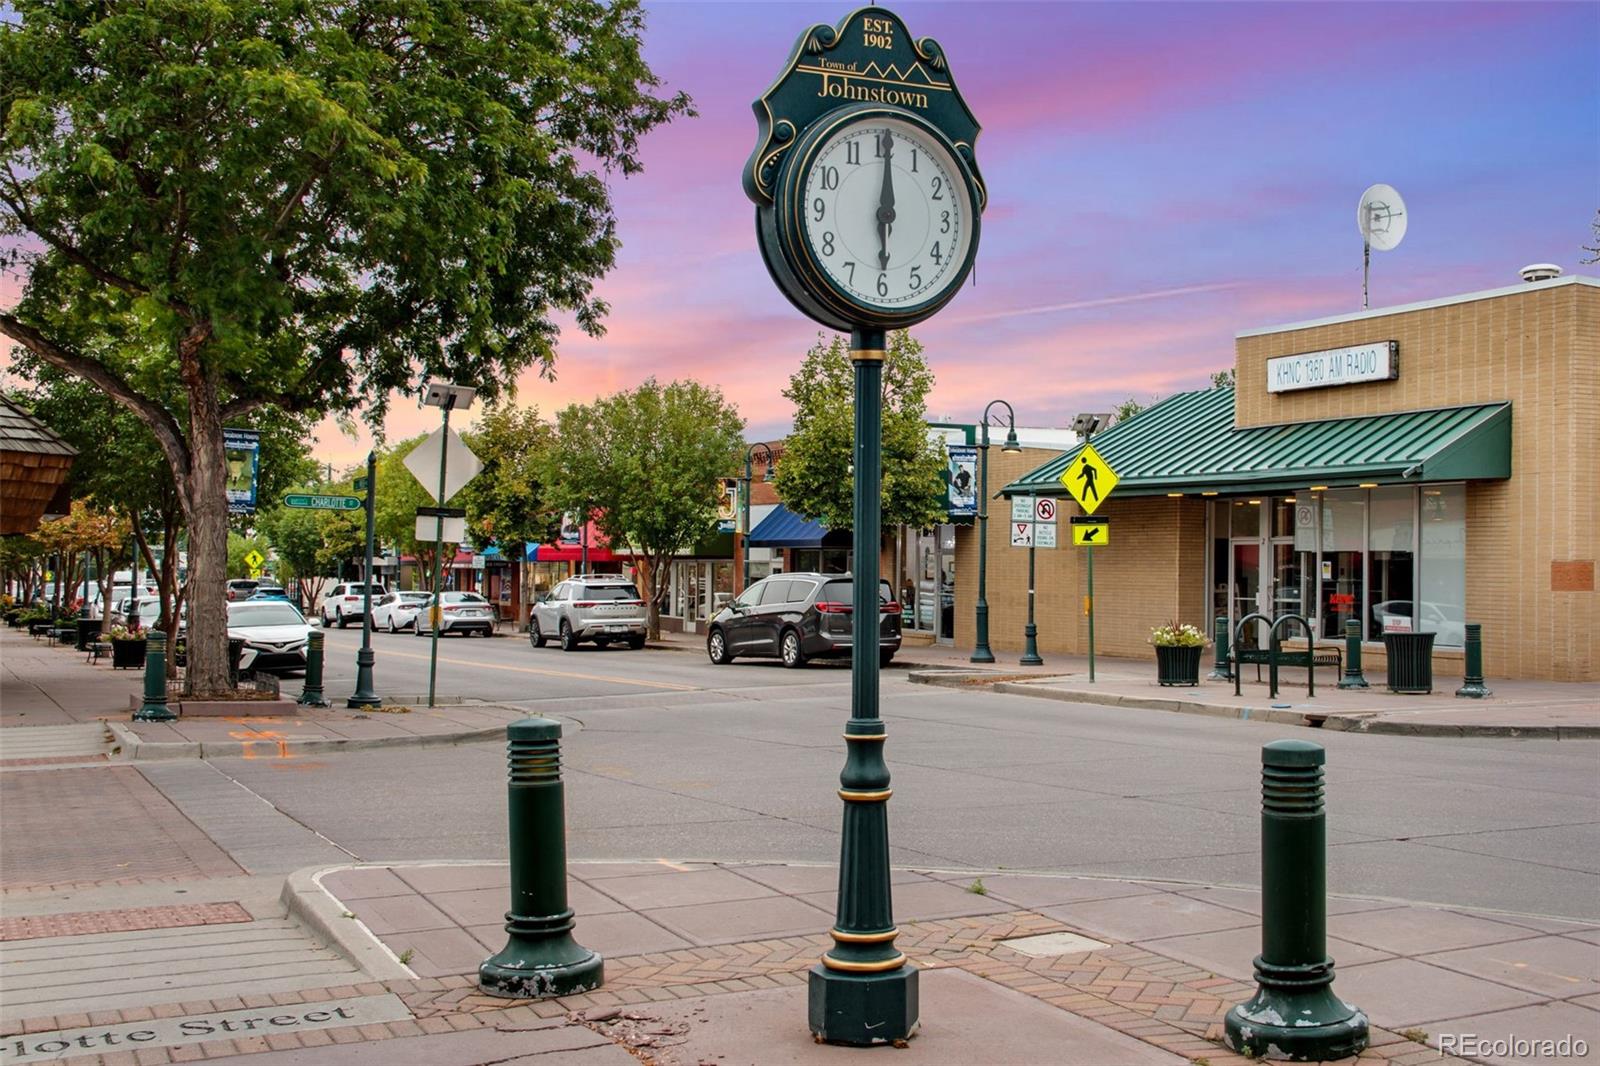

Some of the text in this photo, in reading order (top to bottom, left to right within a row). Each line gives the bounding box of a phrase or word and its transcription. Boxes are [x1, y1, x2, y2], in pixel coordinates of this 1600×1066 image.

[863, 17, 894, 34] EST.
[863, 33, 893, 50] 1902
[818, 56, 858, 72] Town of
[818, 73, 928, 109] Johnstown
[845, 141, 861, 165] 11
[910, 148, 919, 173] 1
[820, 165, 839, 190] 10
[931, 176, 944, 201] 2
[813, 197, 825, 222] 9
[940, 210, 950, 234] 3
[821, 231, 835, 256] 8
[930, 240, 943, 266] 4
[842, 261, 856, 287] 7
[877, 272, 888, 297] 6
[909, 264, 922, 290] 5
[1277, 350, 1377, 385] KHNC 1360 AM RADIO
[312, 496, 347, 510] CHARLOTTE
[0, 1006, 356, 1057] lotte Street
